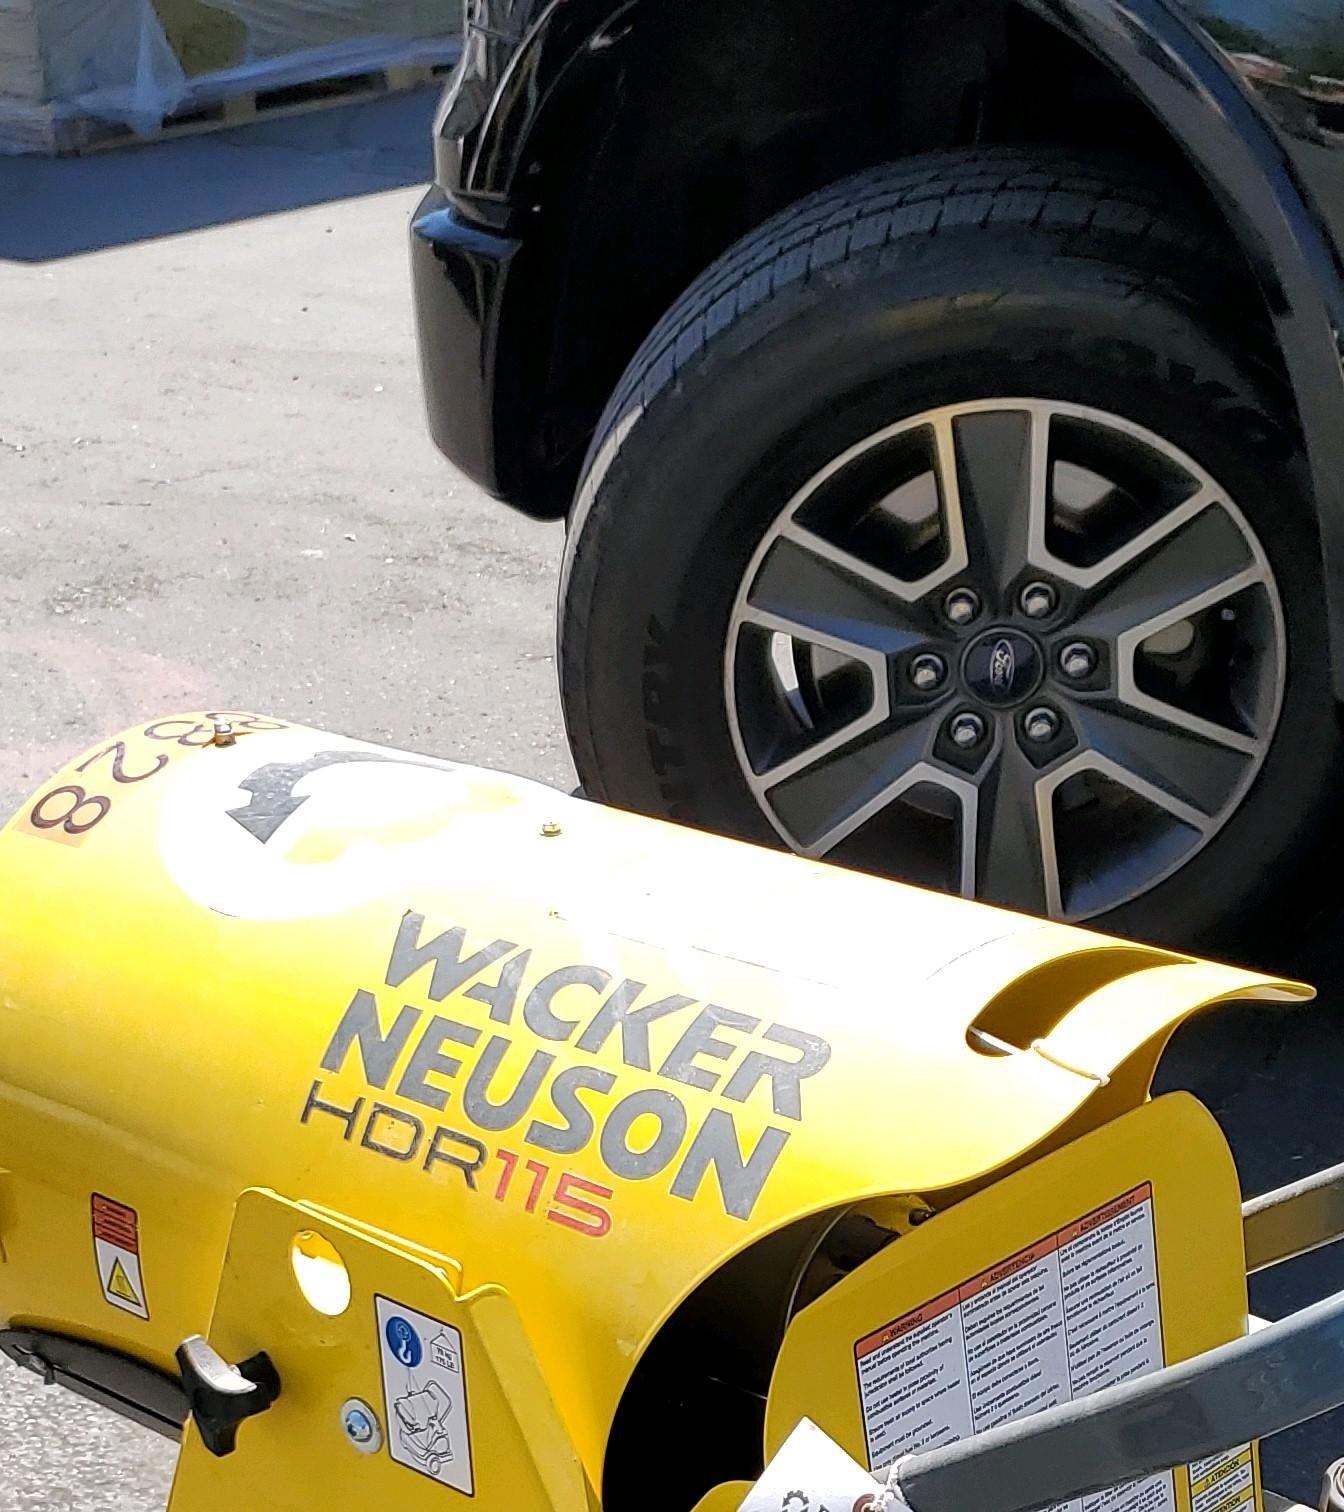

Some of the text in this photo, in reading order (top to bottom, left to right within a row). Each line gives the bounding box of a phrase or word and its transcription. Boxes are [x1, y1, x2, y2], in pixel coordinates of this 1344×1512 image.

[320, 988, 791, 1221] NEUSON
[385, 911, 832, 1121] WACKER
[299, 1080, 614, 1239] HDR115
